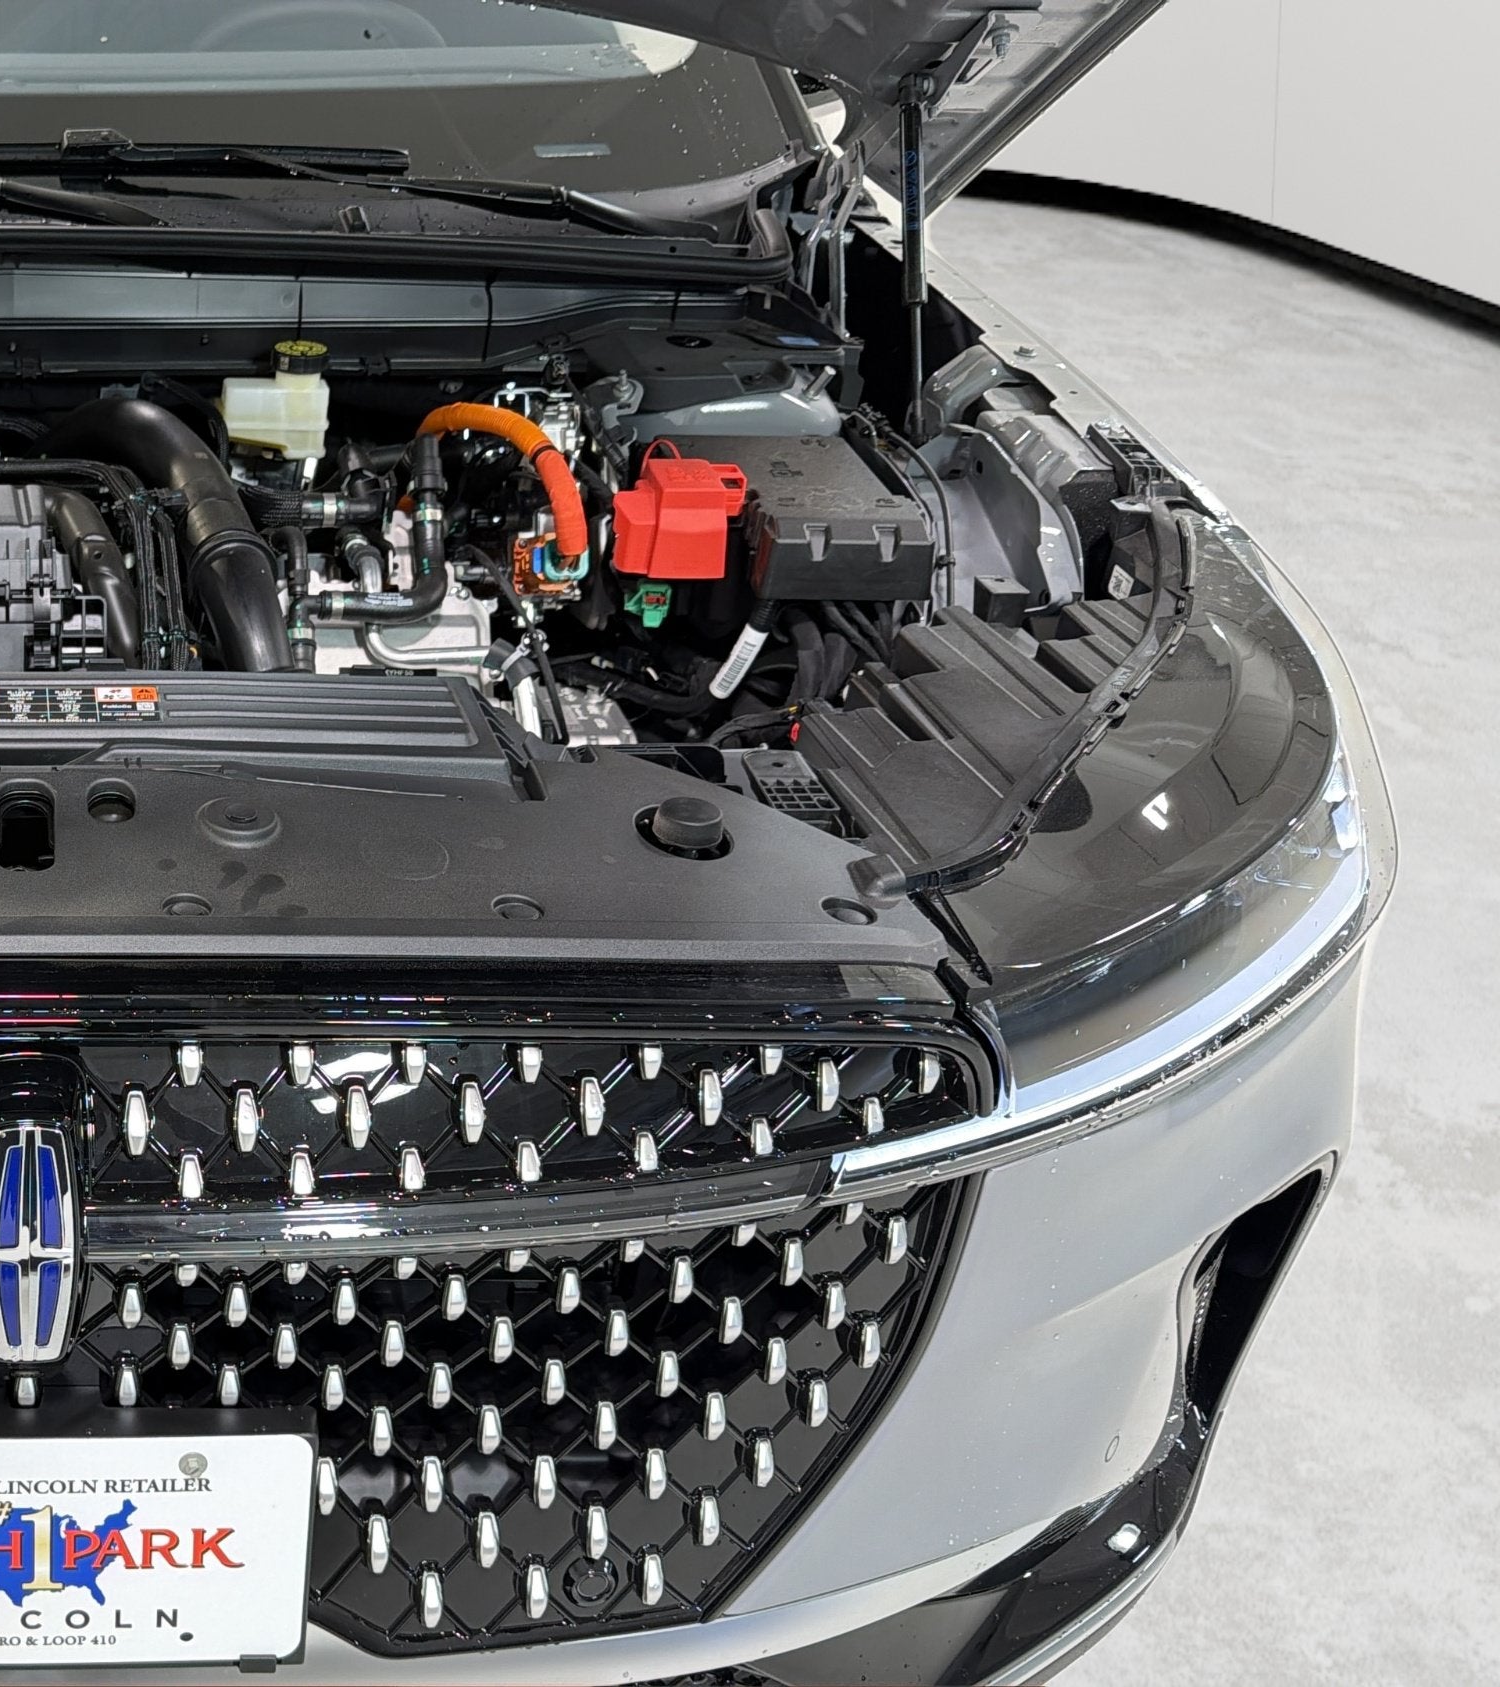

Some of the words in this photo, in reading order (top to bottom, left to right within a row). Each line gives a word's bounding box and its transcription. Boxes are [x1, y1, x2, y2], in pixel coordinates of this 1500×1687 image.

[104, 1477, 213, 1493] RETAILER
[63, 1527, 246, 1570] PARK
[25, 1636, 38, 1646] &
[43, 1635, 87, 1646] LOOP
[90, 1634, 117, 1646] 410
